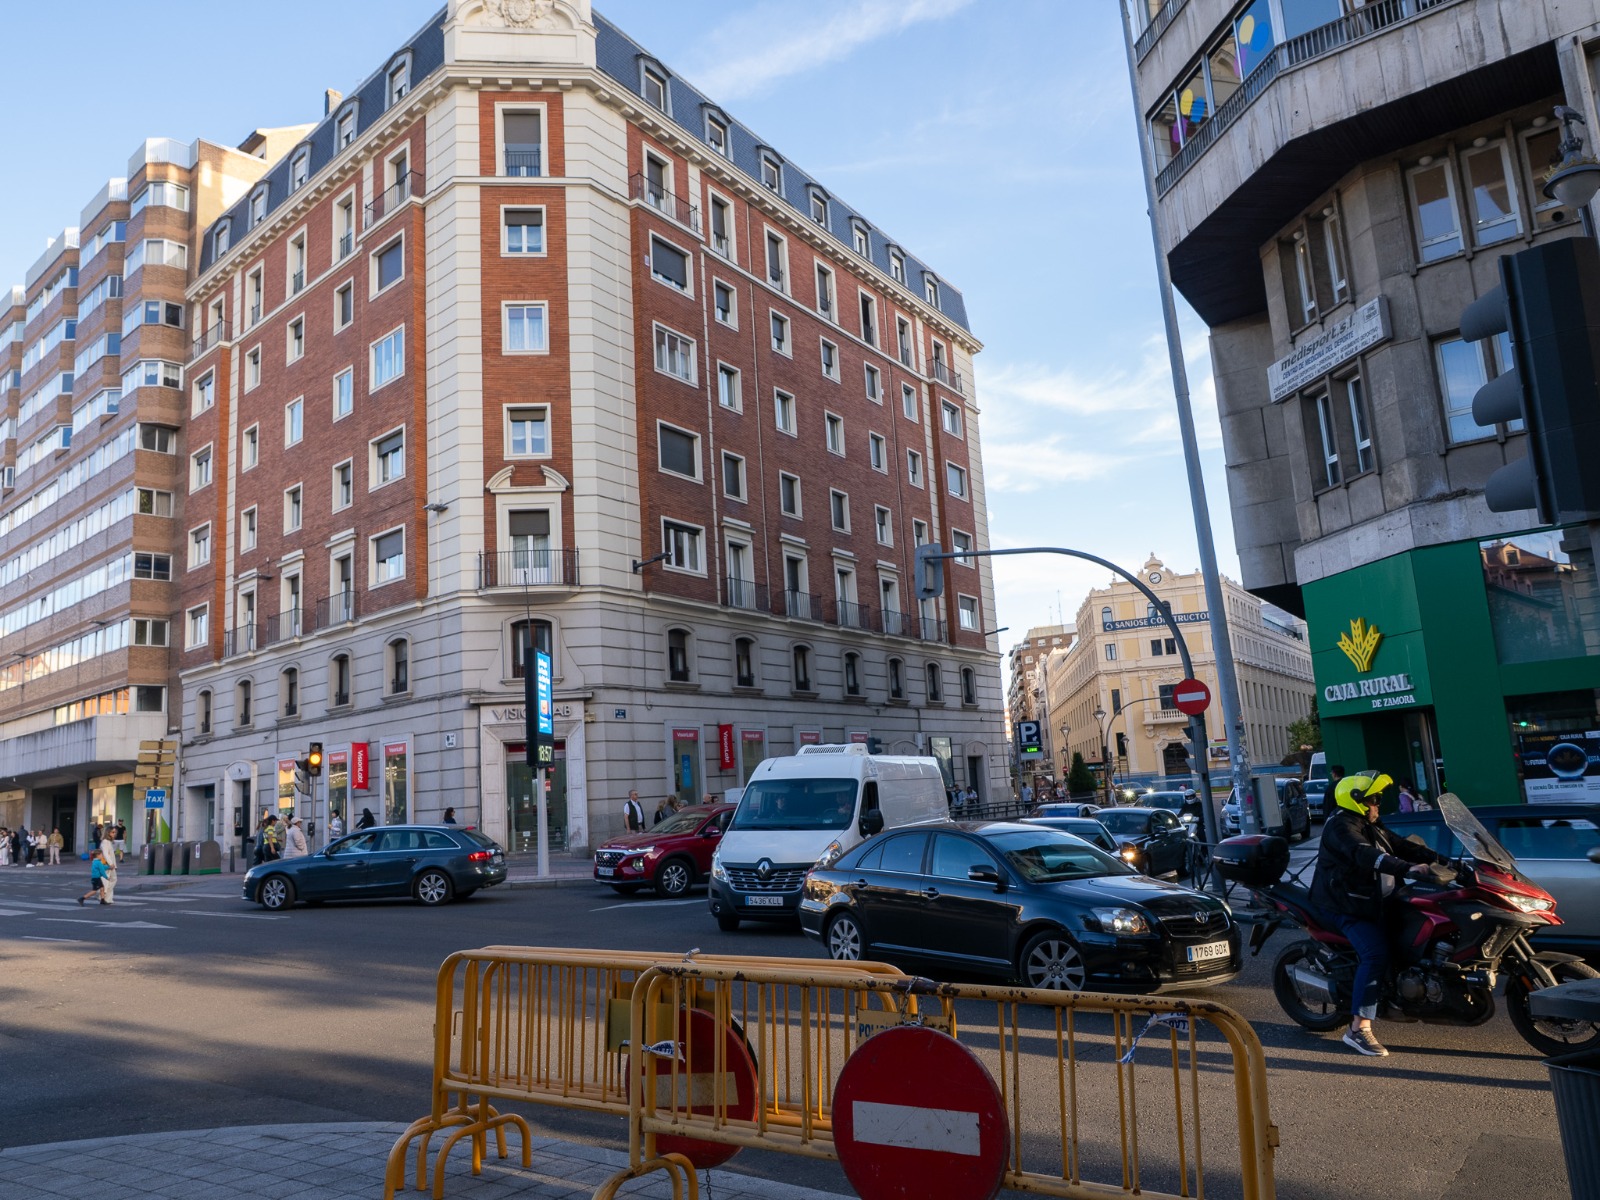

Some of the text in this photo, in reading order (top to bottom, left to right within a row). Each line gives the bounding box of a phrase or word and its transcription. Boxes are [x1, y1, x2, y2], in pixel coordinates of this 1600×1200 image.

[1116, 618, 1148, 628] SANJOSE
[1324, 674, 1412, 702] CAJA RURAL
[1372, 695, 1416, 708] DE ZAMORA
[1020, 722, 1037, 742] P
[1195, 944, 1227, 958] 1769 GDX
